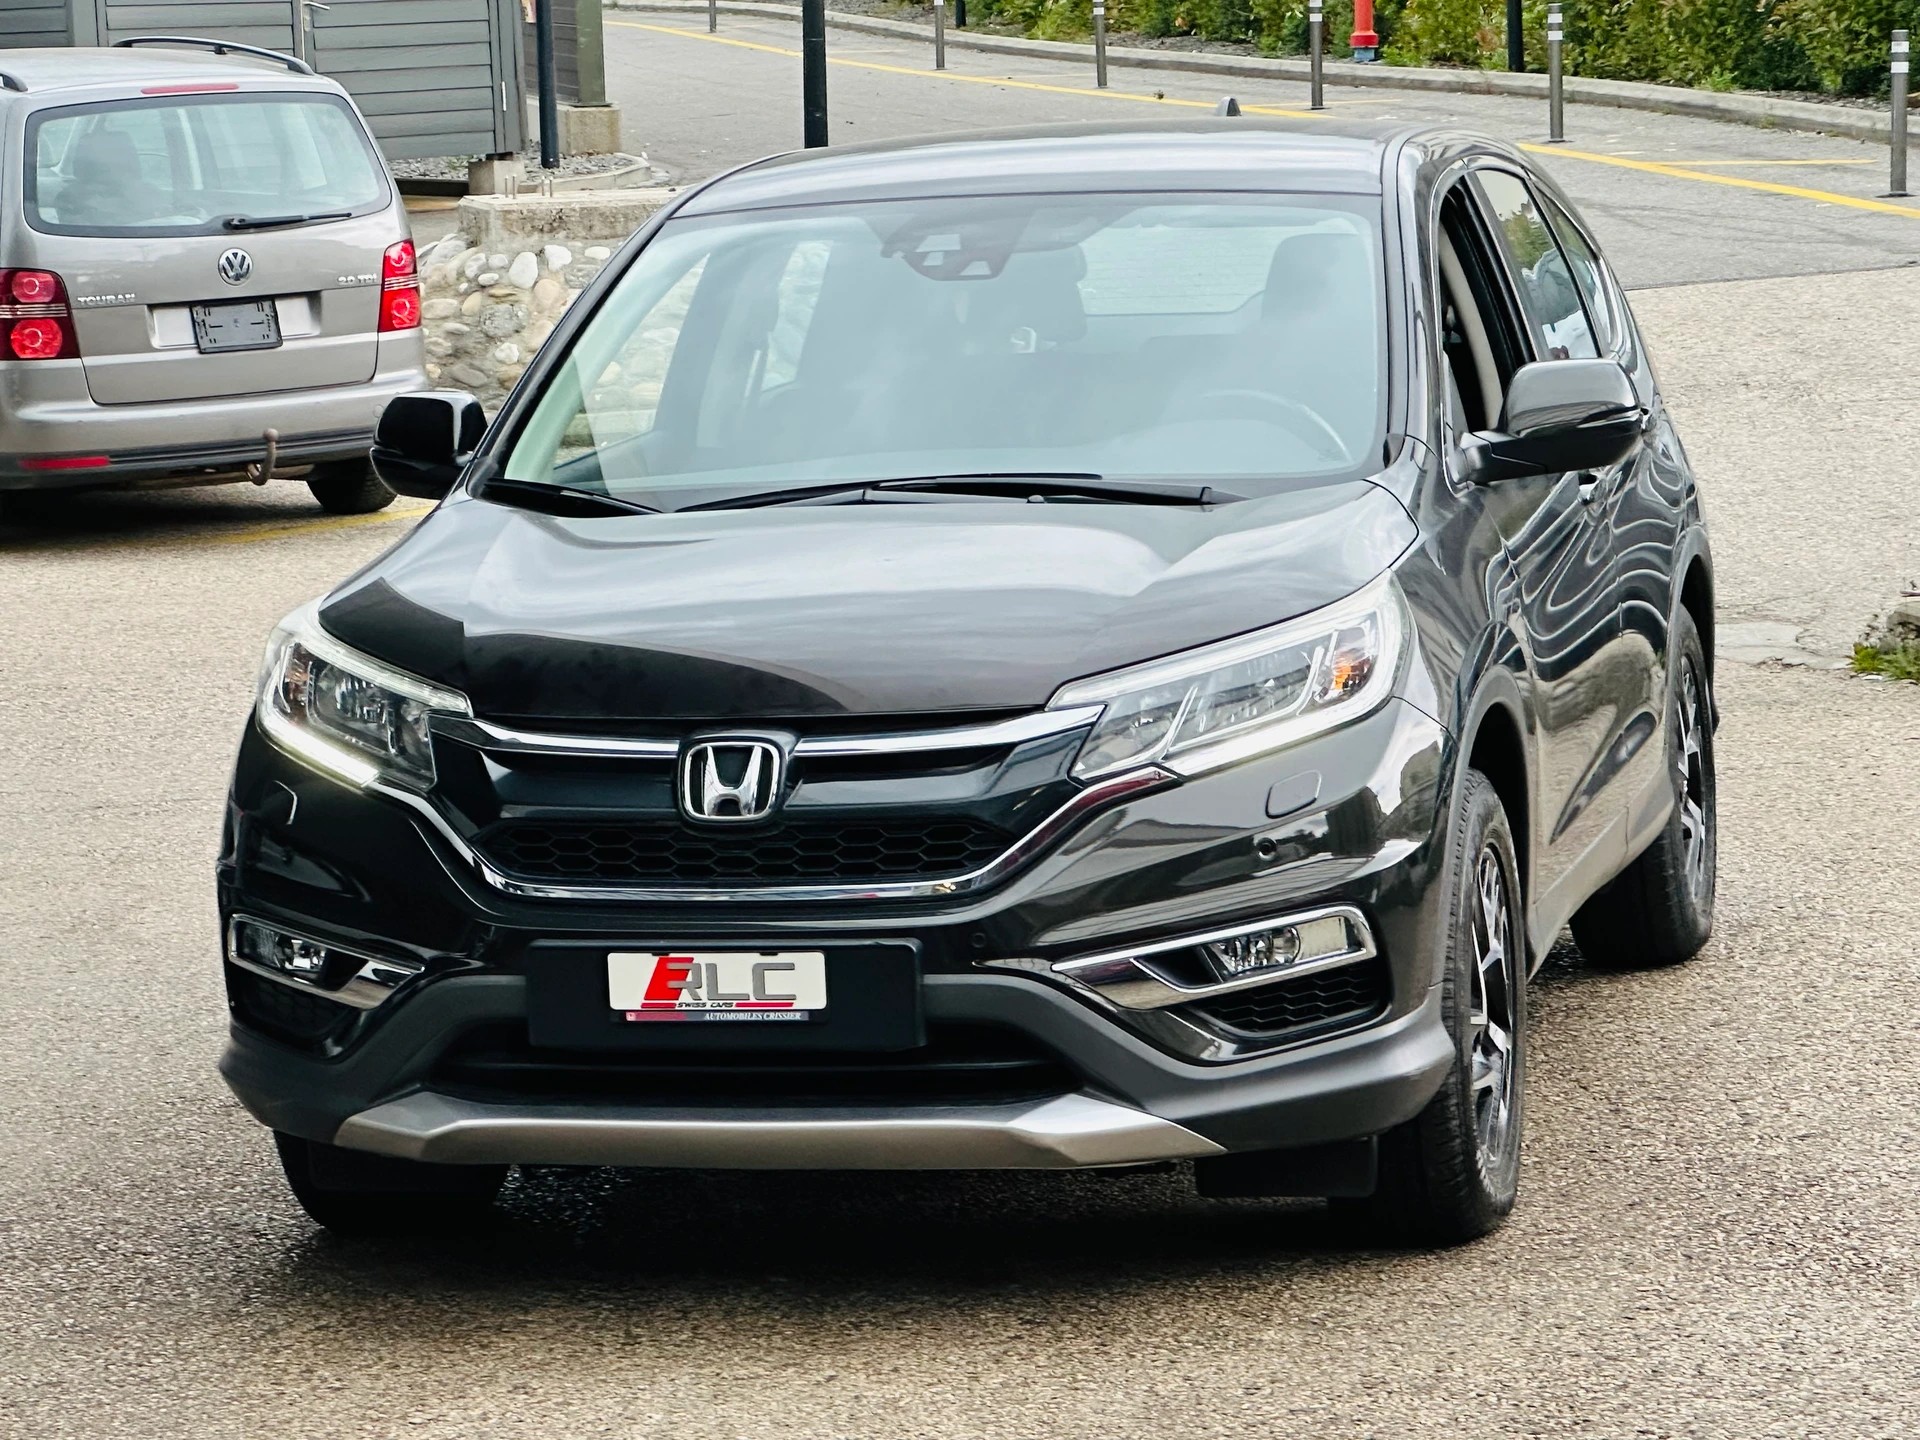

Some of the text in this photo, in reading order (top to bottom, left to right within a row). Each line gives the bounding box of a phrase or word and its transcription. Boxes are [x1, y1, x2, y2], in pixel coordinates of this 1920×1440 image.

[77, 293, 136, 306] TOURAN
[704, 1011, 802, 1021] AUTOMOBILES CRISSIER
